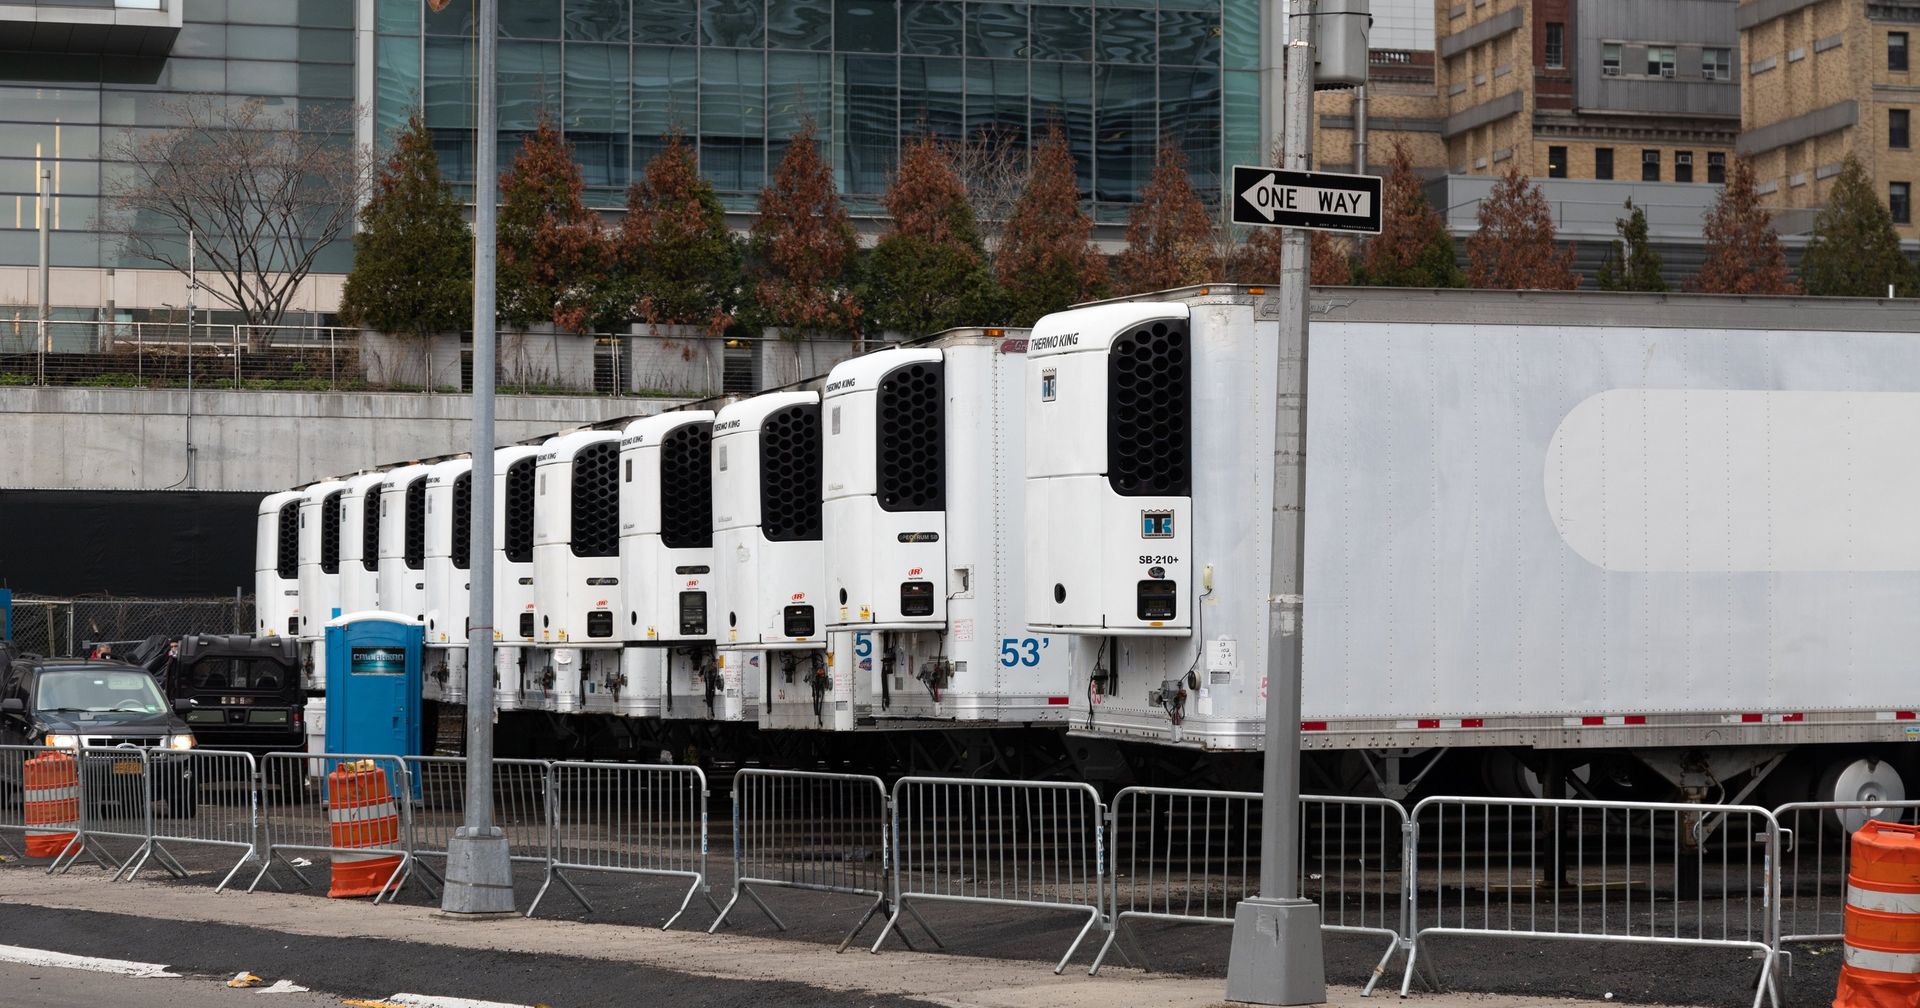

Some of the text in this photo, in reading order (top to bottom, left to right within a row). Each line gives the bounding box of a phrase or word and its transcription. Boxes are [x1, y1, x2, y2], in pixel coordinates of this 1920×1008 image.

[1257, 186, 1362, 213] ONE WAY
[1031, 333, 1079, 350] THERMO KING
[842, 378, 856, 388] KING
[728, 420, 740, 429] KING
[1139, 556, 1179, 564] SB-210+
